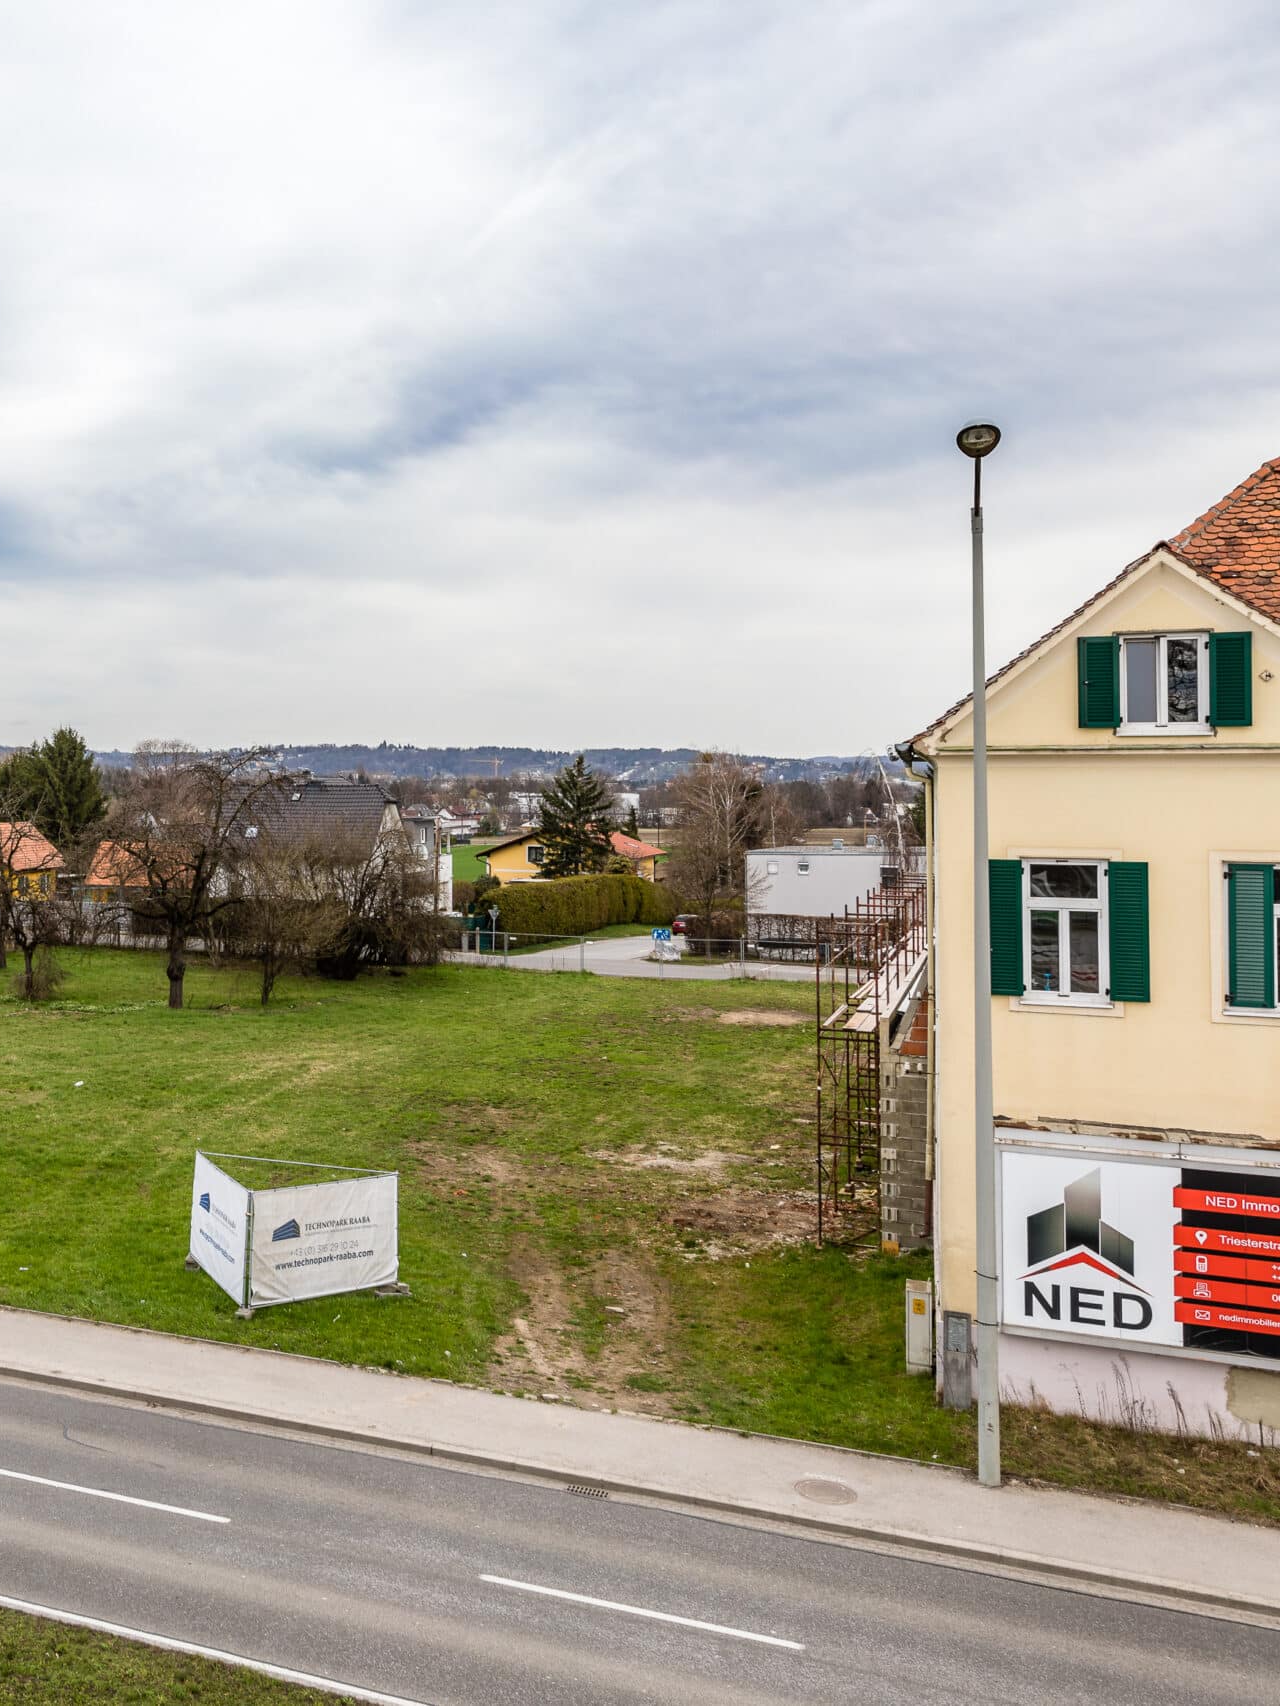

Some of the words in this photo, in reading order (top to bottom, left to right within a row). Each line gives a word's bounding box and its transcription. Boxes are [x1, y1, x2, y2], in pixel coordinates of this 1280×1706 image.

[1205, 1195, 1238, 1209] NED
[1241, 1199, 1280, 1213] Immo
[305, 1218, 349, 1231] TECHNOPARK
[349, 1216, 371, 1226] RAABA
[275, 1249, 374, 1271] www.technopark-raaba.com
[1024, 1280, 1153, 1330] NED
